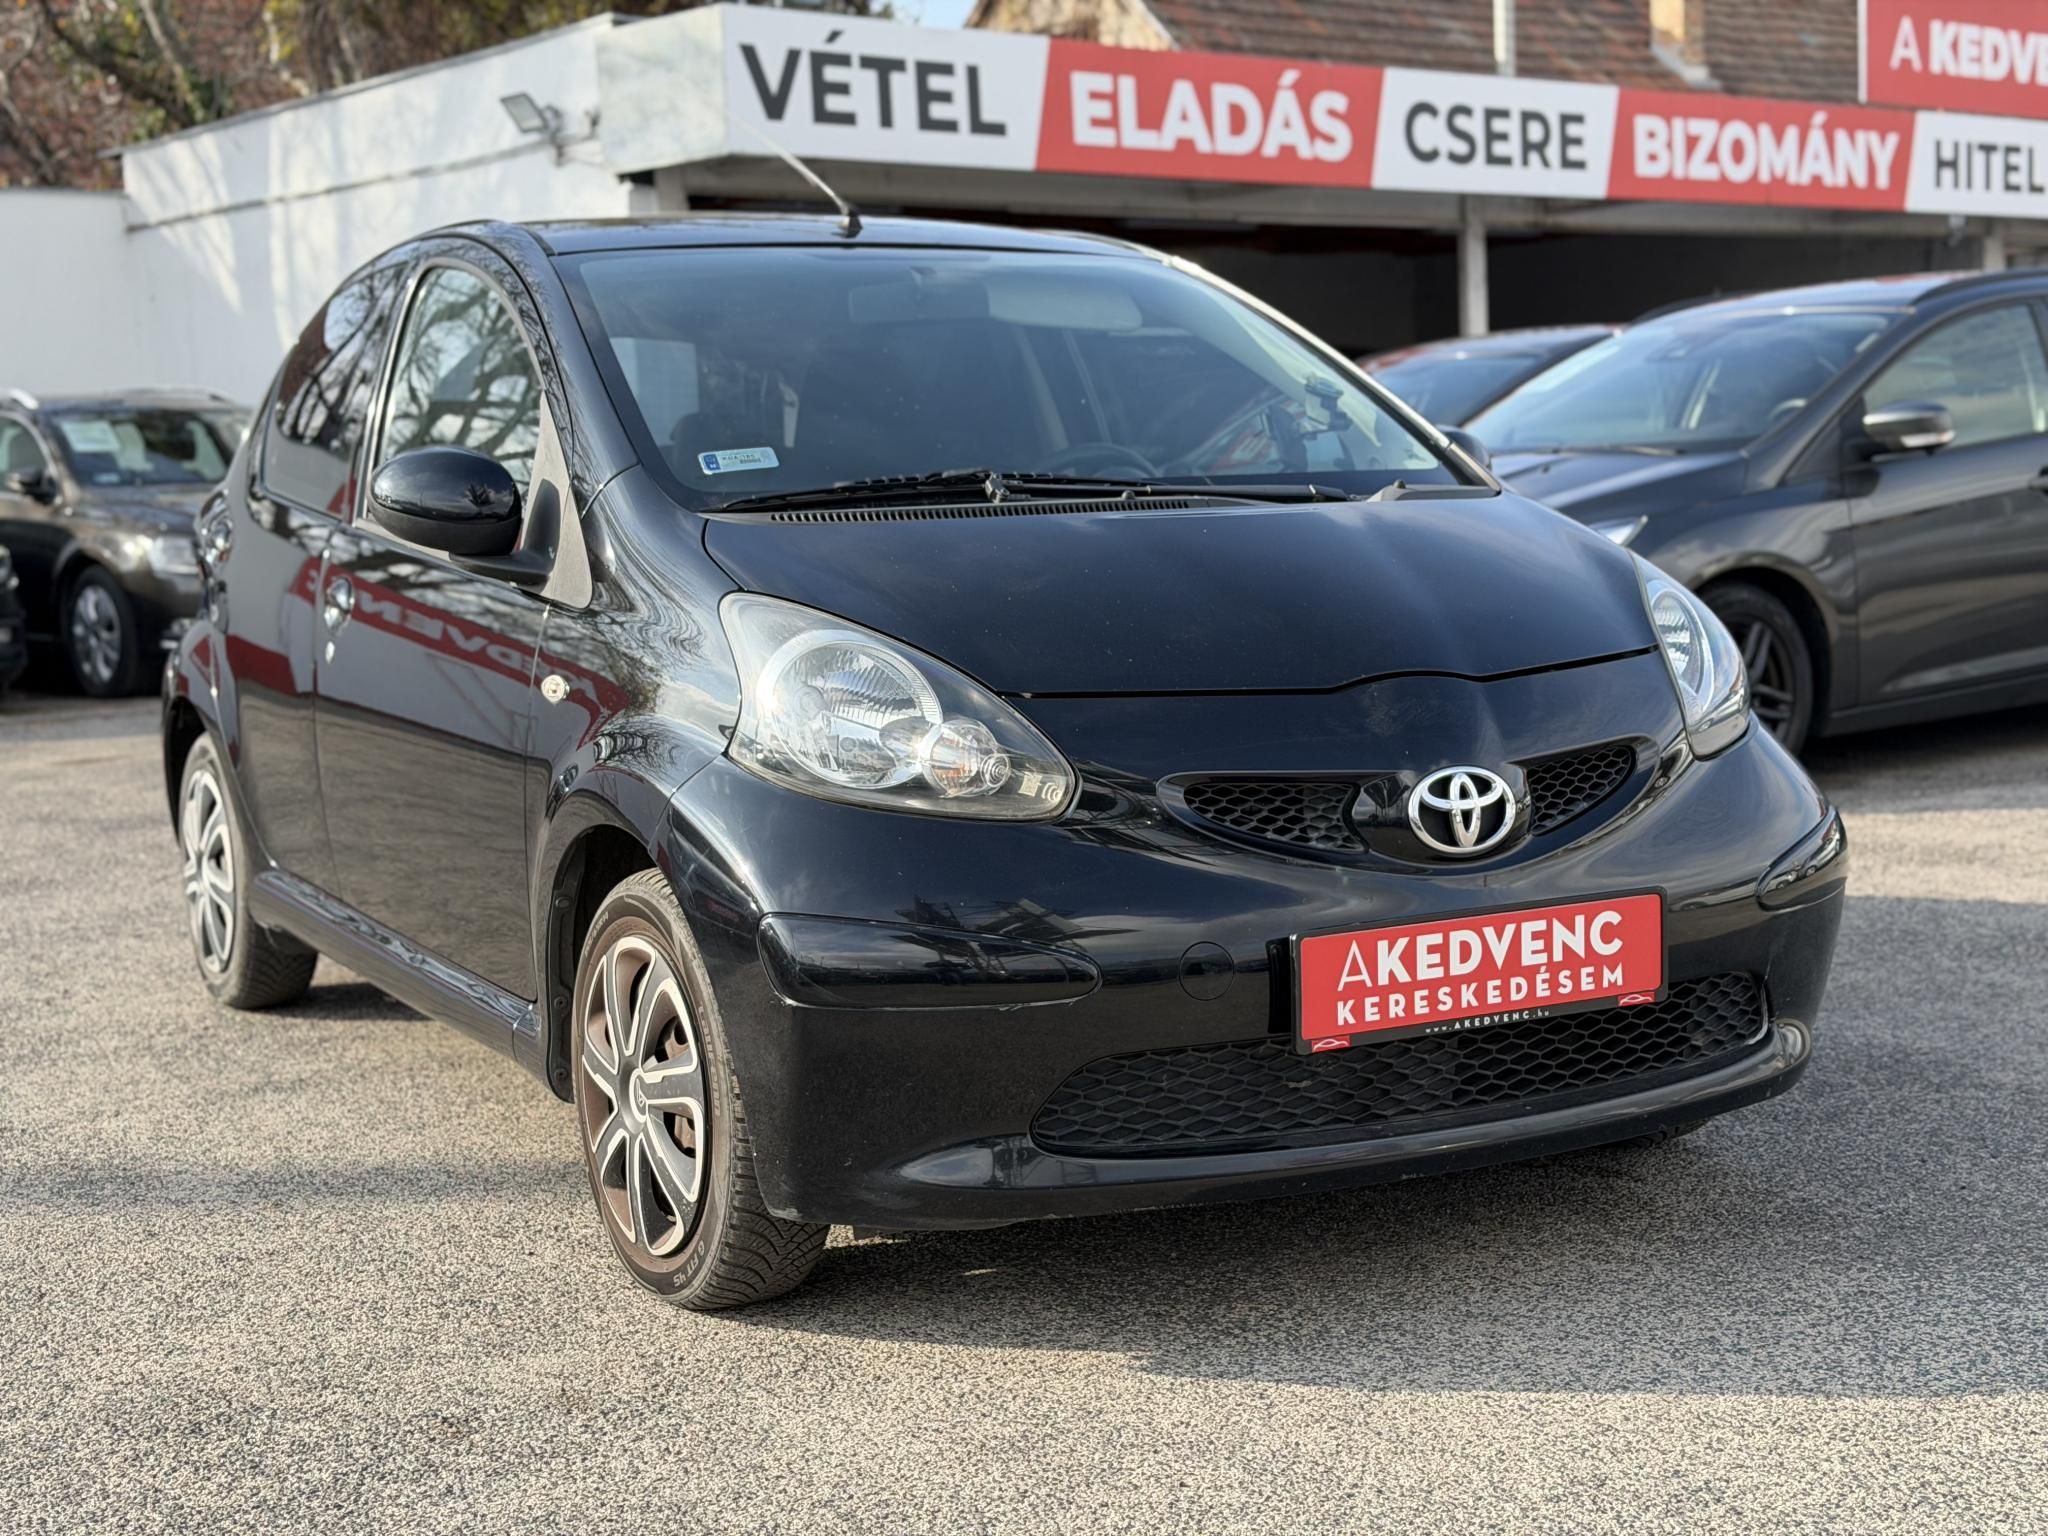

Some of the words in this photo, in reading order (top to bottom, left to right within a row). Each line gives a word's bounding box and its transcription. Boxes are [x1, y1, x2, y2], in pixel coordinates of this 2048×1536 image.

[1889, 15, 1923, 73] A
[739, 30, 1007, 137] VÉTEL
[1069, 69, 1354, 163] ELADÁS
[1405, 101, 1588, 171] CSERE
[1632, 111, 1900, 190] BIZOMÁNY
[1935, 138, 2045, 194] HITEL
[1336, 962, 1624, 1026] KERESKEDÉSEM
[1425, 1008, 1550, 1034] www.AKEDVENC.hu
